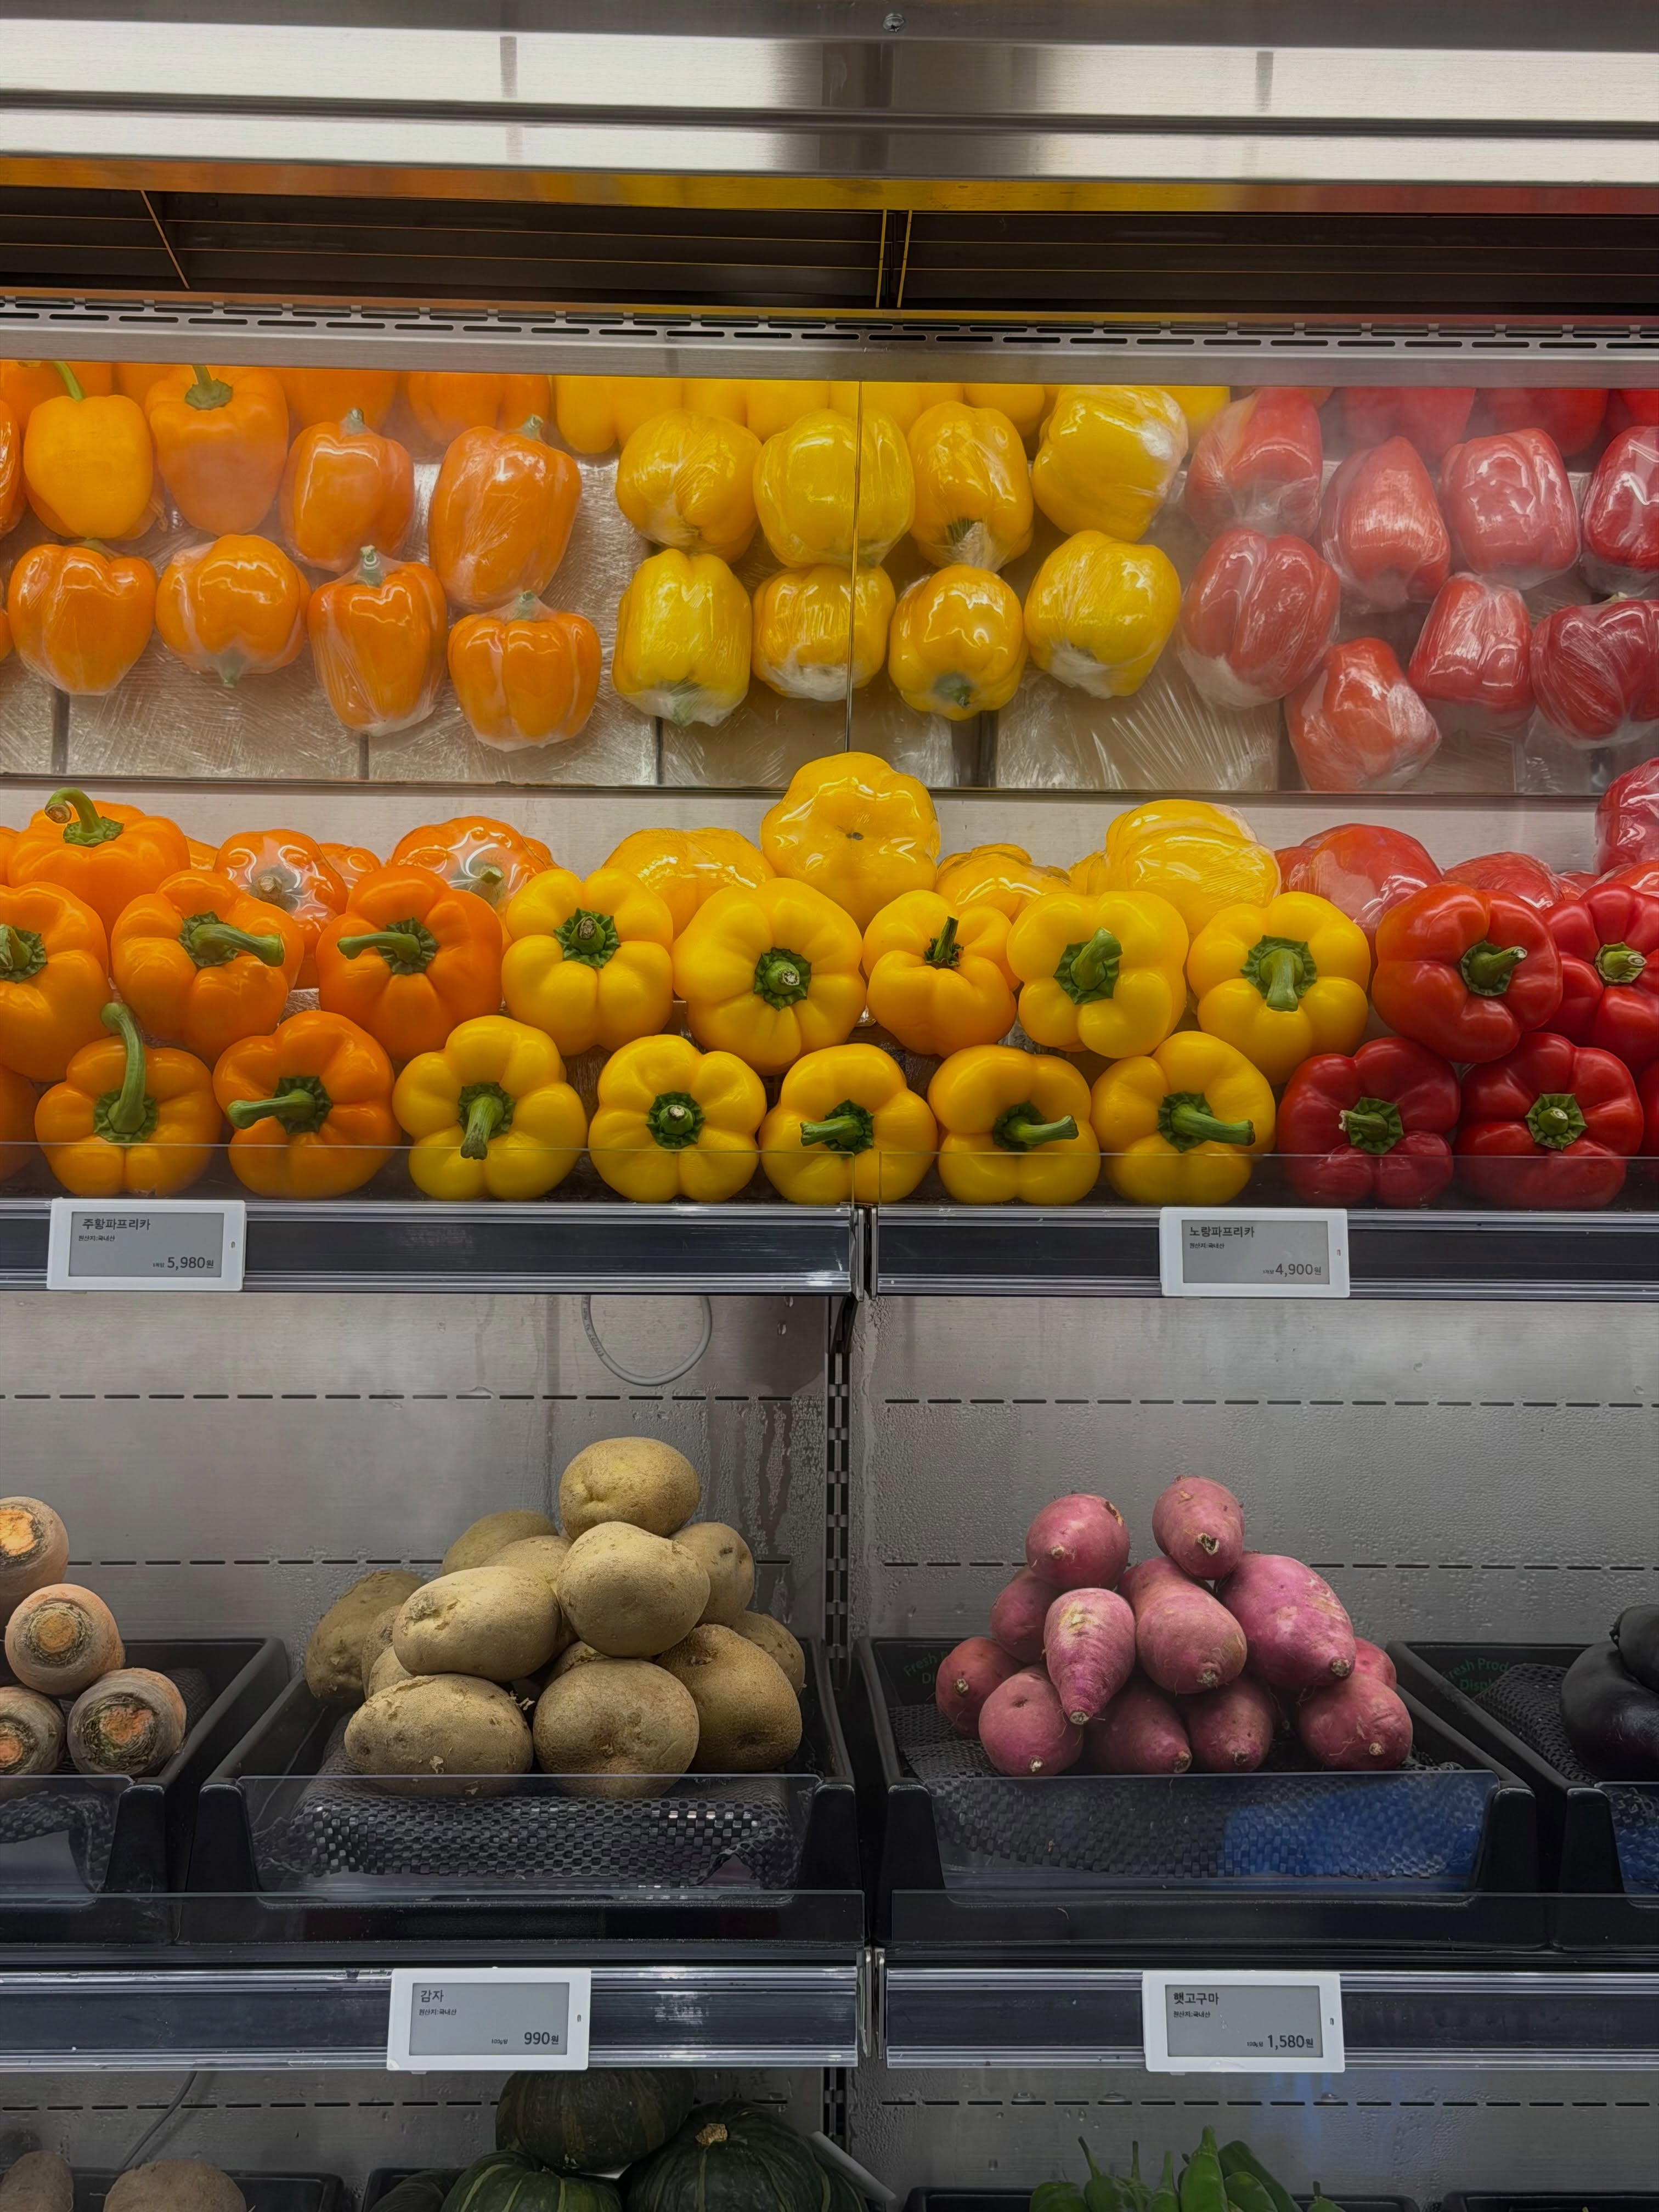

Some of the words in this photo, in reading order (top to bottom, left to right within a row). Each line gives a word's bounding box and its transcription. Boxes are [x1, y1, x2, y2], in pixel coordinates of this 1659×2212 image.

[82, 1218, 151, 1231] 주황파프리카
[1189, 1226, 1255, 1238] 노랑파프리카
[167, 1256, 214, 1271] 5,980원
[1276, 1263, 1322, 1277] 4,900원
[904, 1650, 938, 1677] Fresh
[1444, 1658, 1475, 1679] resh
[1477, 1657, 1510, 1673] Prod
[1460, 1677, 1492, 1690] Displ
[420, 1989, 444, 2002] 감자
[1173, 1992, 1219, 2005] 햇고구마
[524, 2032, 559, 2045] 990원
[1267, 2034, 1314, 2050] 1,580원
